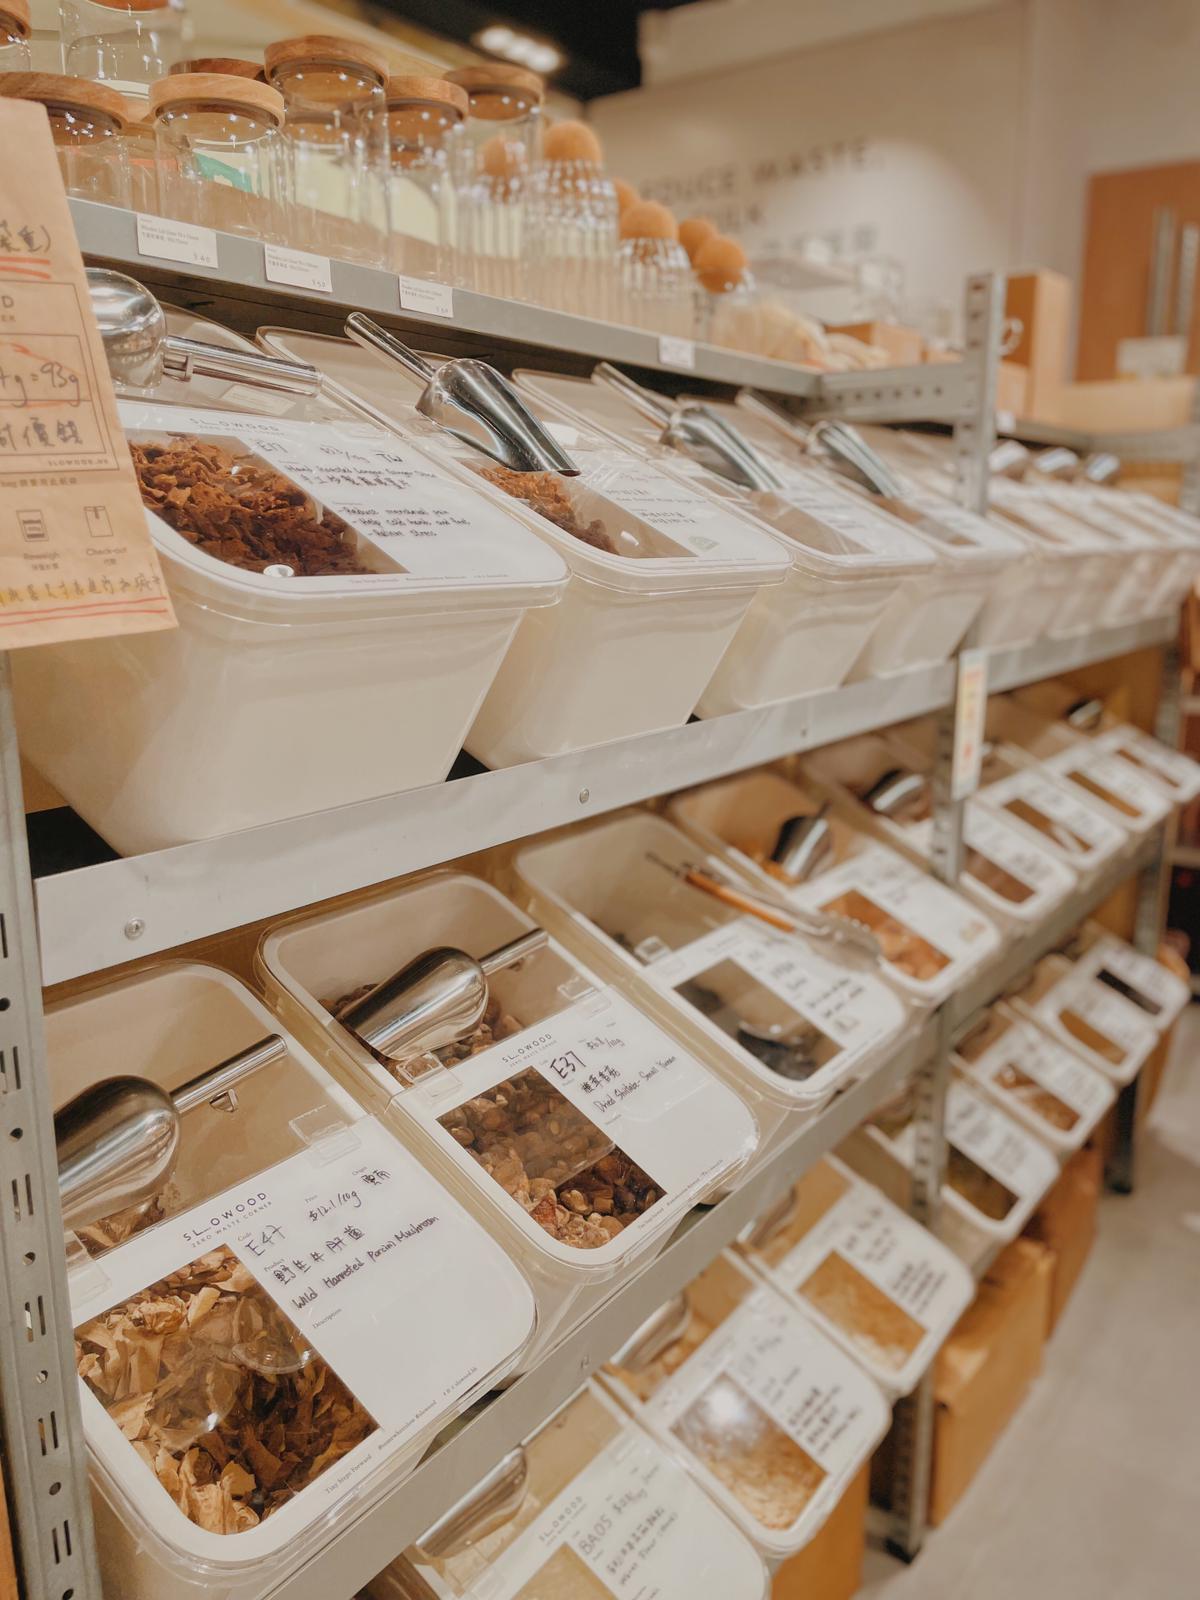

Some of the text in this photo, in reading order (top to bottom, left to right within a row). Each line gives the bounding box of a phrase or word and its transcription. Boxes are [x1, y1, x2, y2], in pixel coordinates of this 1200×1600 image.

[501, 1033, 552, 1064] SLOWOOD
[550, 1050, 587, 1080] E37
[183, 1192, 267, 1241] SLOWOOD
[191, 1201, 272, 1248] ZERO WASTE CORNER
[292, 1287, 319, 1311] Wild
[395, 1215, 440, 1244] Mushroom
